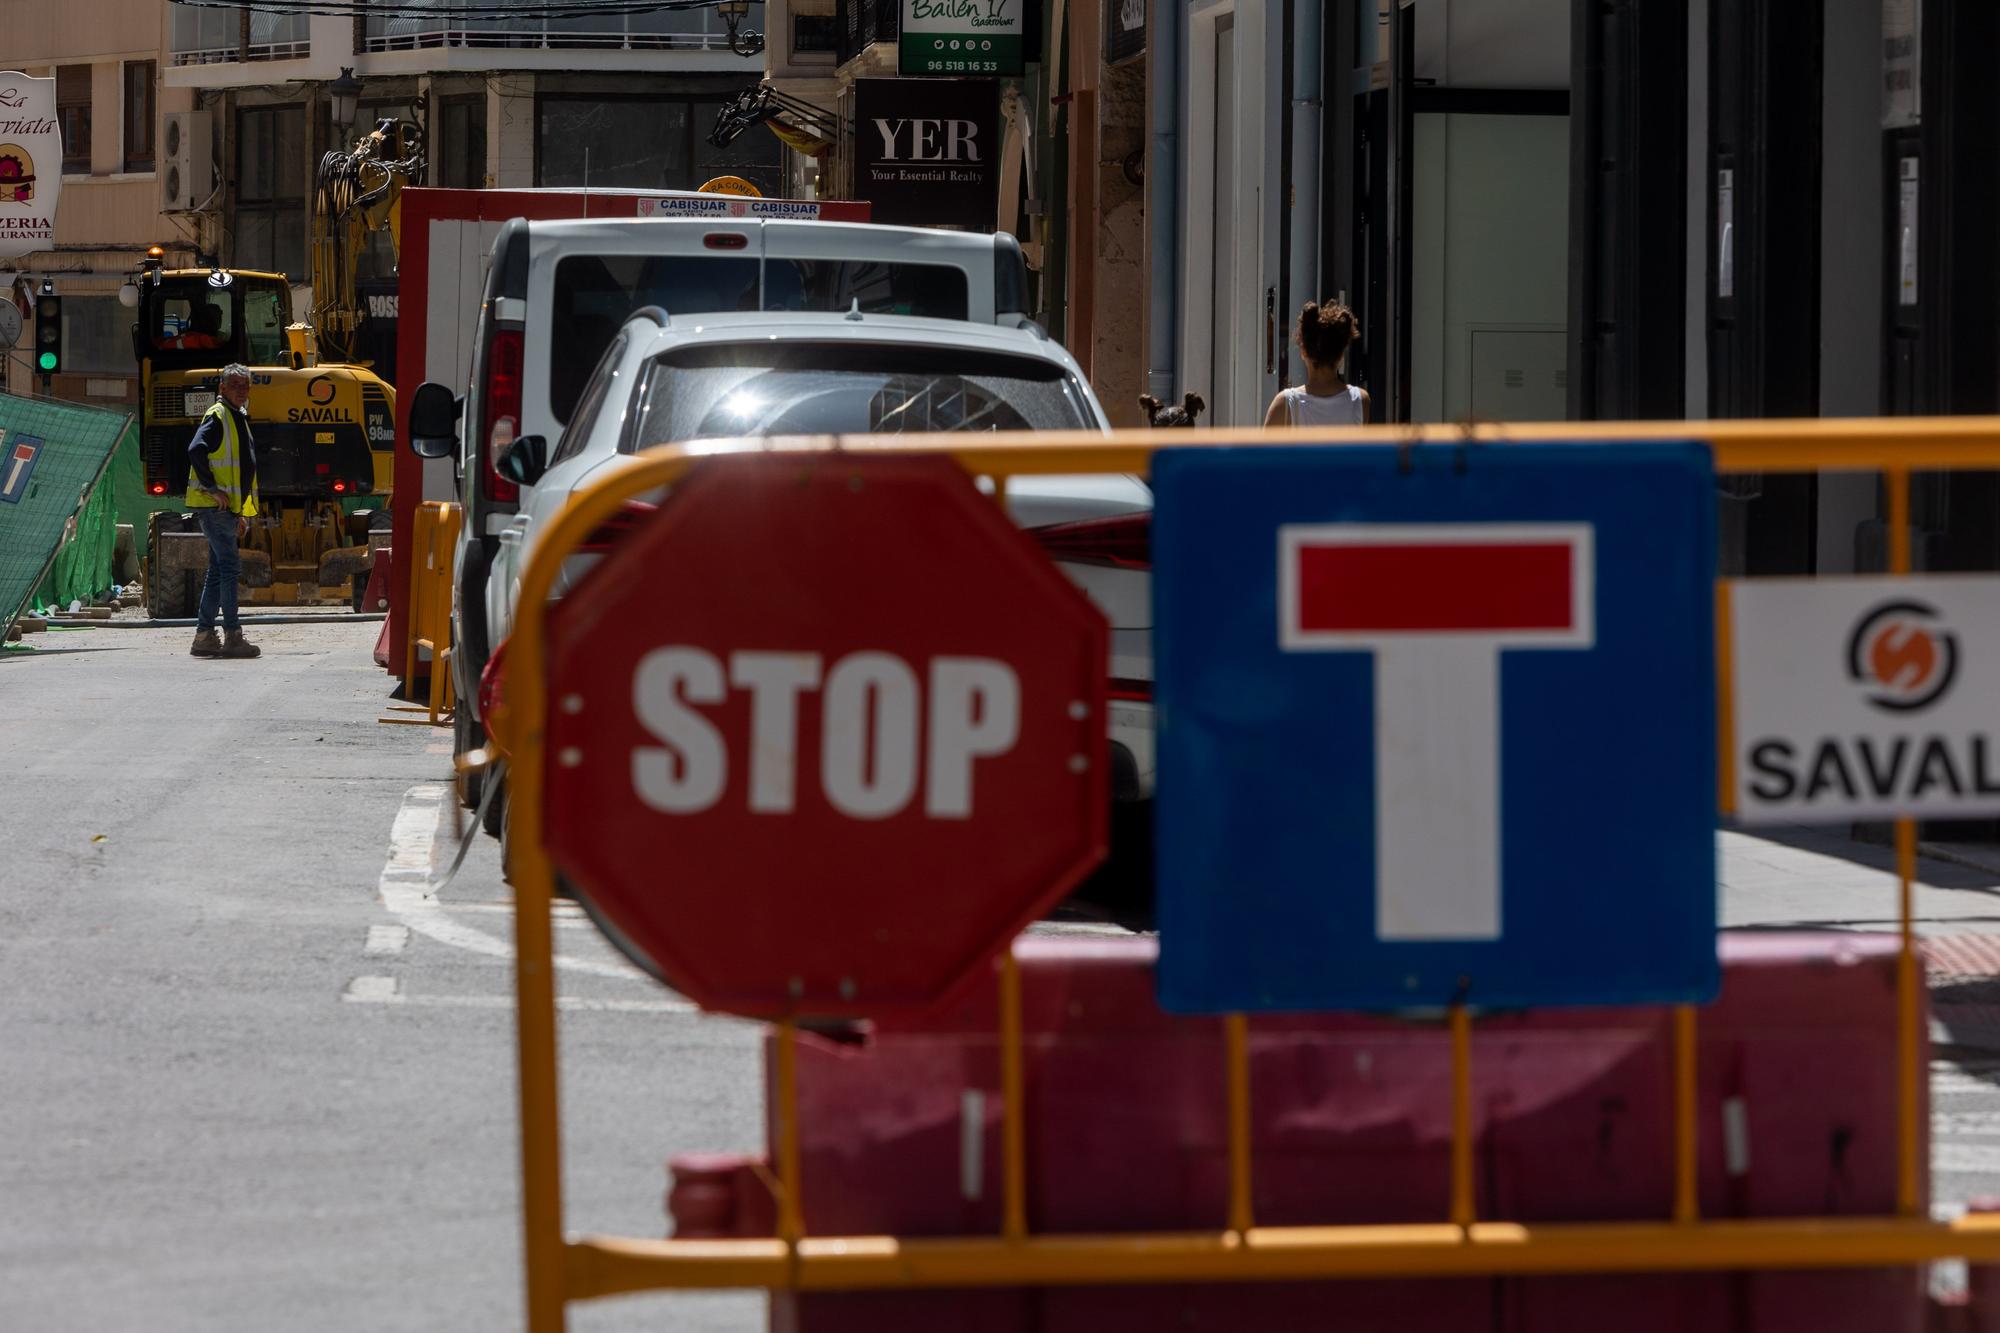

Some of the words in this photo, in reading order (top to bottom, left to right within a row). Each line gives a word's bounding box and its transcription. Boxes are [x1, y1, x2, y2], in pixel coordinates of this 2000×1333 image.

[971, 16, 1015, 27] Gastrobar
[927, 61, 942, 71] 96
[945, 61, 965, 71] 518
[968, 62, 980, 71] 16
[983, 62, 997, 71] 33
[871, 118, 982, 161] YER
[871, 169, 896, 180] Your
[900, 169, 946, 181] Essential
[950, 170, 984, 184] Realty
[661, 200, 727, 211] CABISUAR
[752, 203, 818, 214] CABISUAR
[288, 408, 353, 422] SAVALL
[369, 414, 384, 425] PW
[631, 645, 1022, 820] STOP
[1748, 736, 2000, 801] SAVAL
